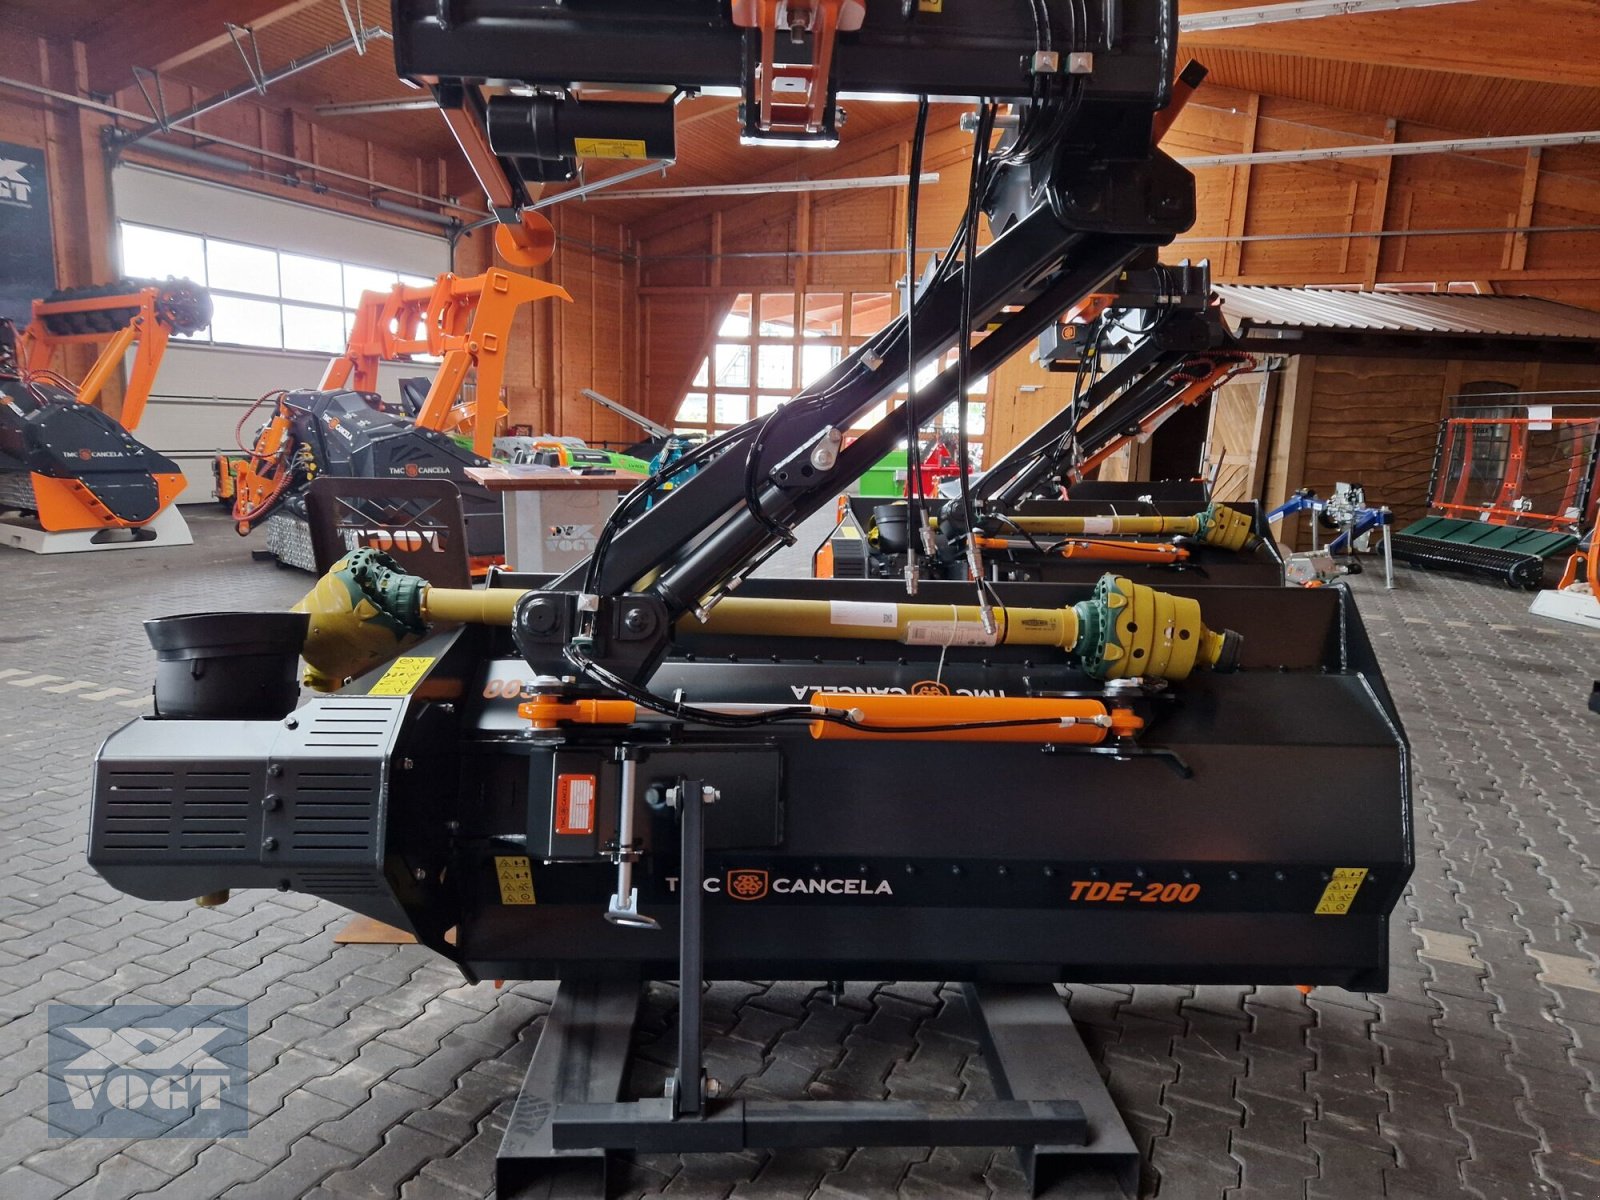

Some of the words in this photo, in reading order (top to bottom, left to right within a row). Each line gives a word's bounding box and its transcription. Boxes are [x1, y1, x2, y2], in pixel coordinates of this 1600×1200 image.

[389, 467, 405, 475] TMC
[418, 466, 451, 474] CANCELA
[665, 877, 721, 893] TC
[772, 878, 893, 895] CANCELA
[1070, 881, 1201, 903] TDE-200
